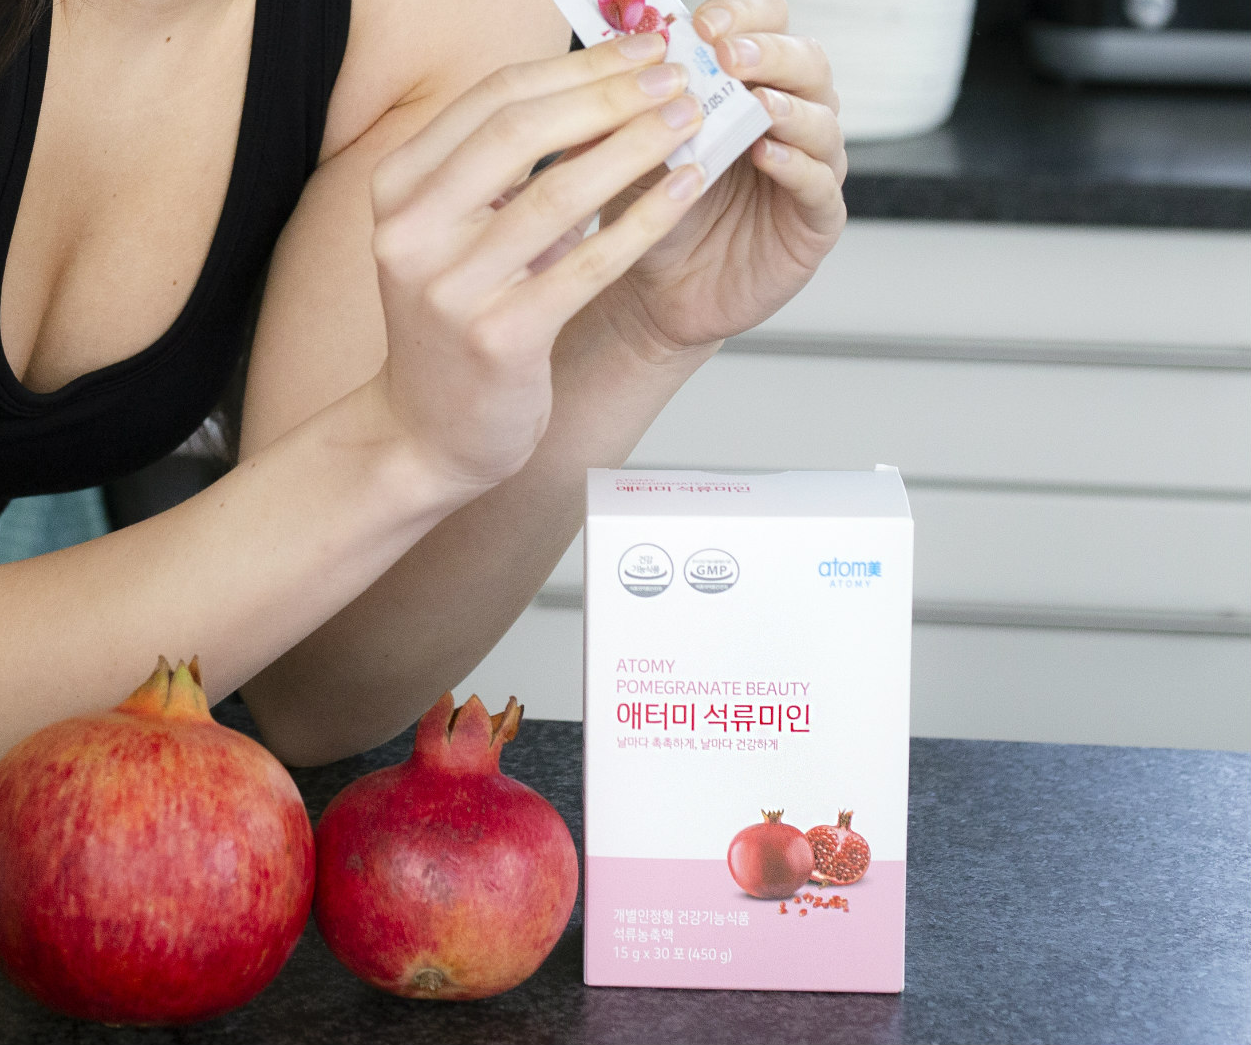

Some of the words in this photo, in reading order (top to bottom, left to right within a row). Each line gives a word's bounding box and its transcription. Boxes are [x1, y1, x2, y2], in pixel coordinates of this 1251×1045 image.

[696, 565, 727, 576] GMP
[829, 580, 871, 588] ATOMY
[616, 659, 675, 673] ATOMY
[616, 680, 742, 695] POMEGRANATE
[746, 682, 810, 696] BEAUTY
[617, 702, 695, 731] 애터미
[703, 704, 810, 732] 석류미인
[617, 737, 649, 748] 날마다
[700, 739, 733, 750] 날마다
[736, 739, 779, 751] 건강하게
[677, 910, 750, 926] 건강기능식품
[613, 927, 674, 943] 석류농축액
[613, 946, 629, 959] 15
[632, 949, 640, 962] g
[653, 947, 670, 960] 30
[673, 948, 686, 960] 포
[688, 947, 717, 961] (450
[720, 948, 732, 964] g)
